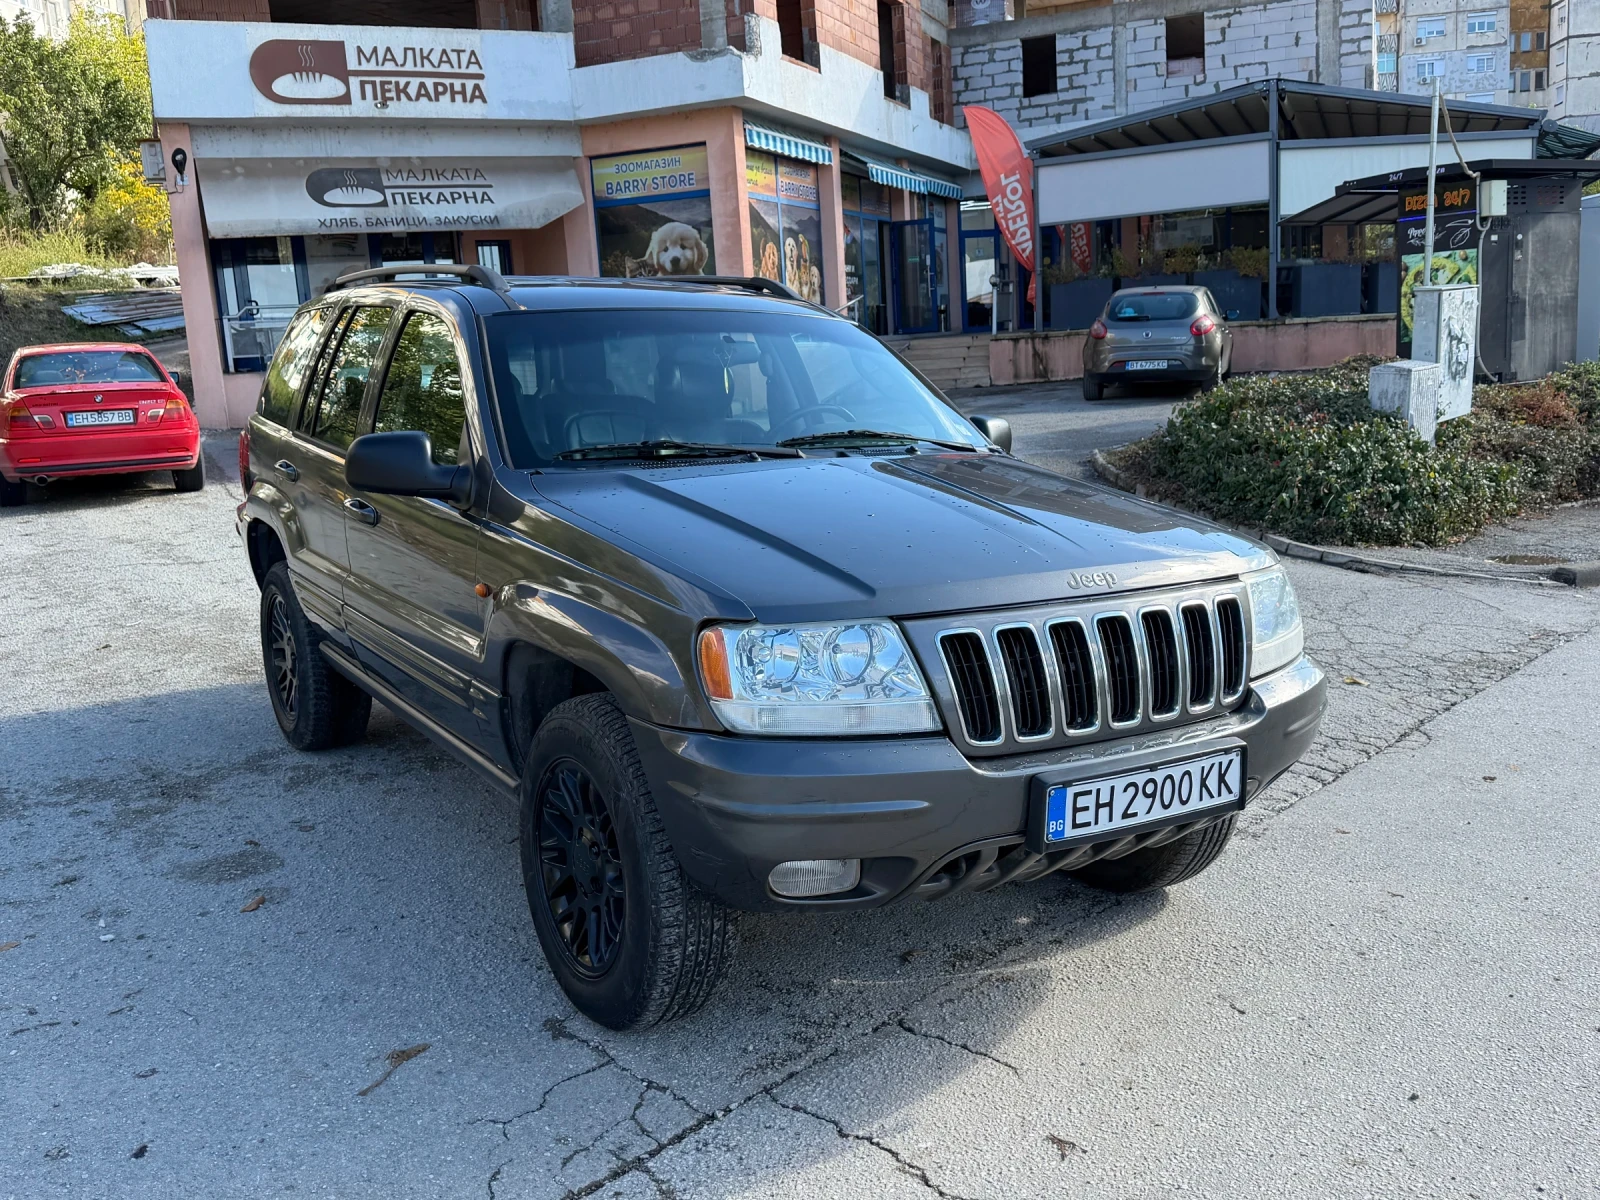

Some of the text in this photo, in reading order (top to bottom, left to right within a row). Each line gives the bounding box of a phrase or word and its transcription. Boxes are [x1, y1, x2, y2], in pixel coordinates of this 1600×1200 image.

[356, 45, 483, 70] МАЛКАТА
[359, 79, 487, 103] ПЕКАРНА
[614, 156, 681, 174] ЗООМАГАЗИН
[385, 168, 487, 182] МАЛКАТА
[606, 172, 695, 195] BARRY STORE
[391, 191, 495, 205] ПЕКАРНА
[318, 217, 362, 228] ХЛЯБ,
[435, 214, 500, 226] ЗАКУСКИ
[1067, 570, 1117, 589] Jeep
[1049, 820, 1064, 833] BG
